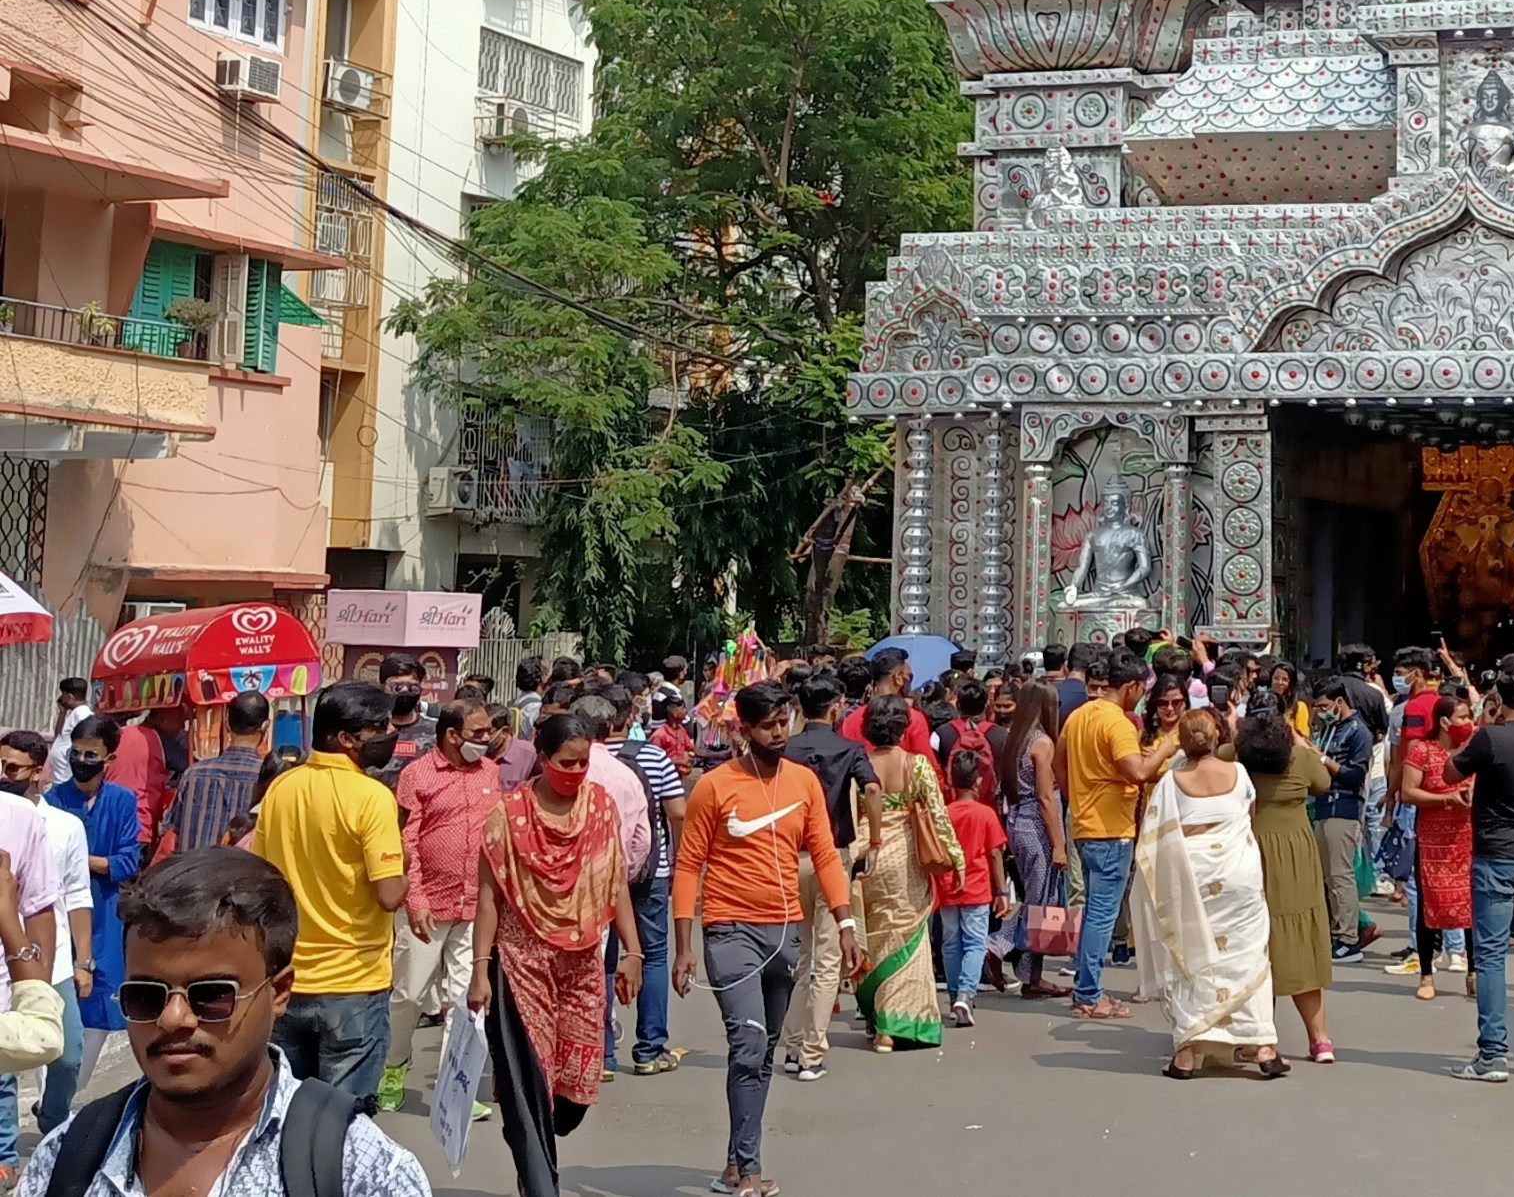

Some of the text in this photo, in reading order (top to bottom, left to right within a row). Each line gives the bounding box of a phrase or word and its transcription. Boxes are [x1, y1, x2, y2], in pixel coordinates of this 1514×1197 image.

[152, 637, 190, 656] WALL'S
[235, 634, 276, 647] KWALITY
[239, 644, 272, 655] WALL'S
